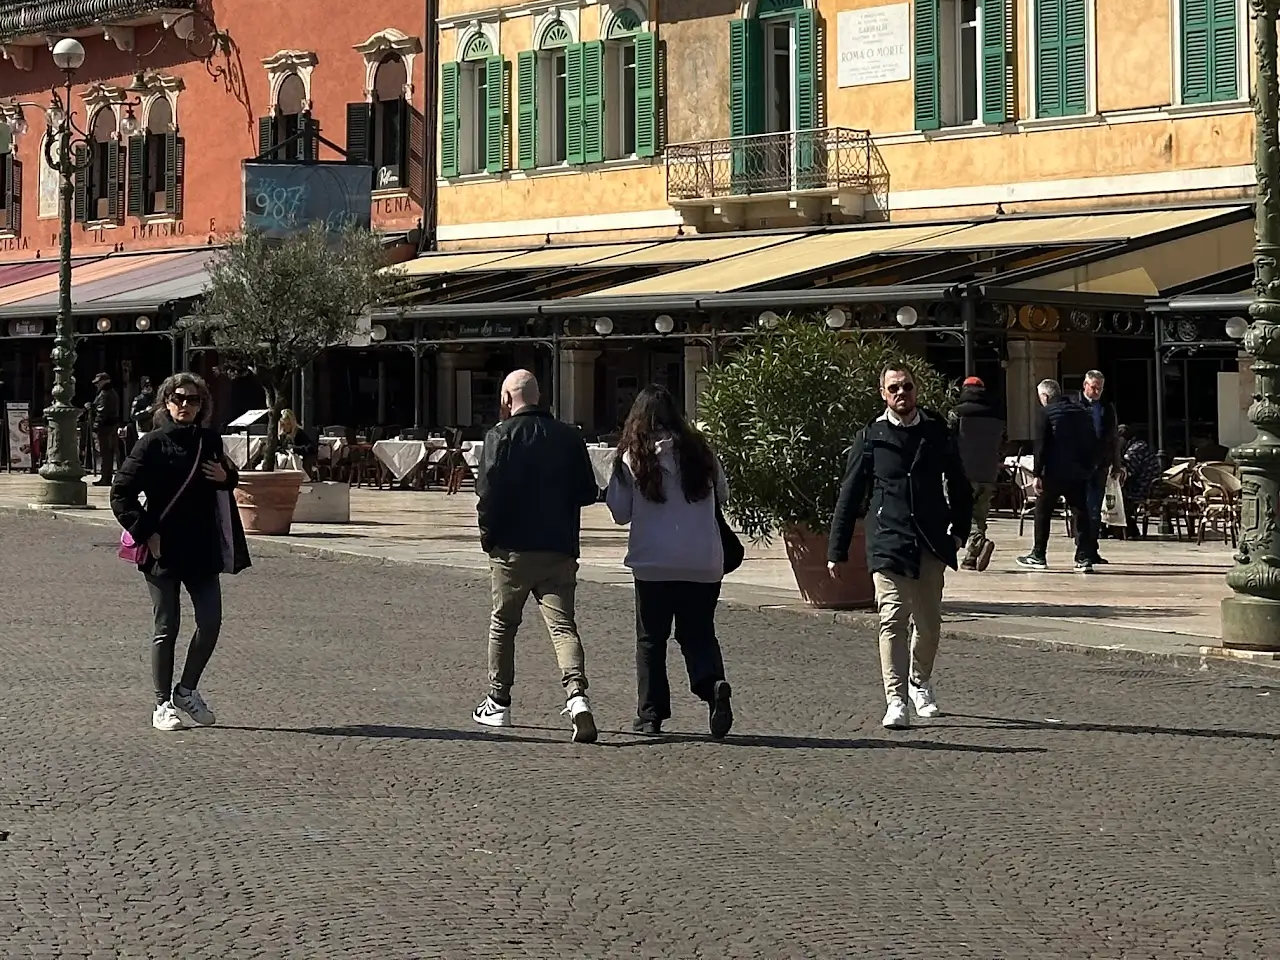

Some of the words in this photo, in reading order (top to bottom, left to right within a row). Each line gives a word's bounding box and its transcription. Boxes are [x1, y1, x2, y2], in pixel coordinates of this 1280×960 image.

[841, 50, 865, 63] ROMA
[866, 48, 874, 59] O
[877, 44, 905, 57] MORTE
[132, 222, 185, 240] TURISMO
[209, 217, 216, 233] E
